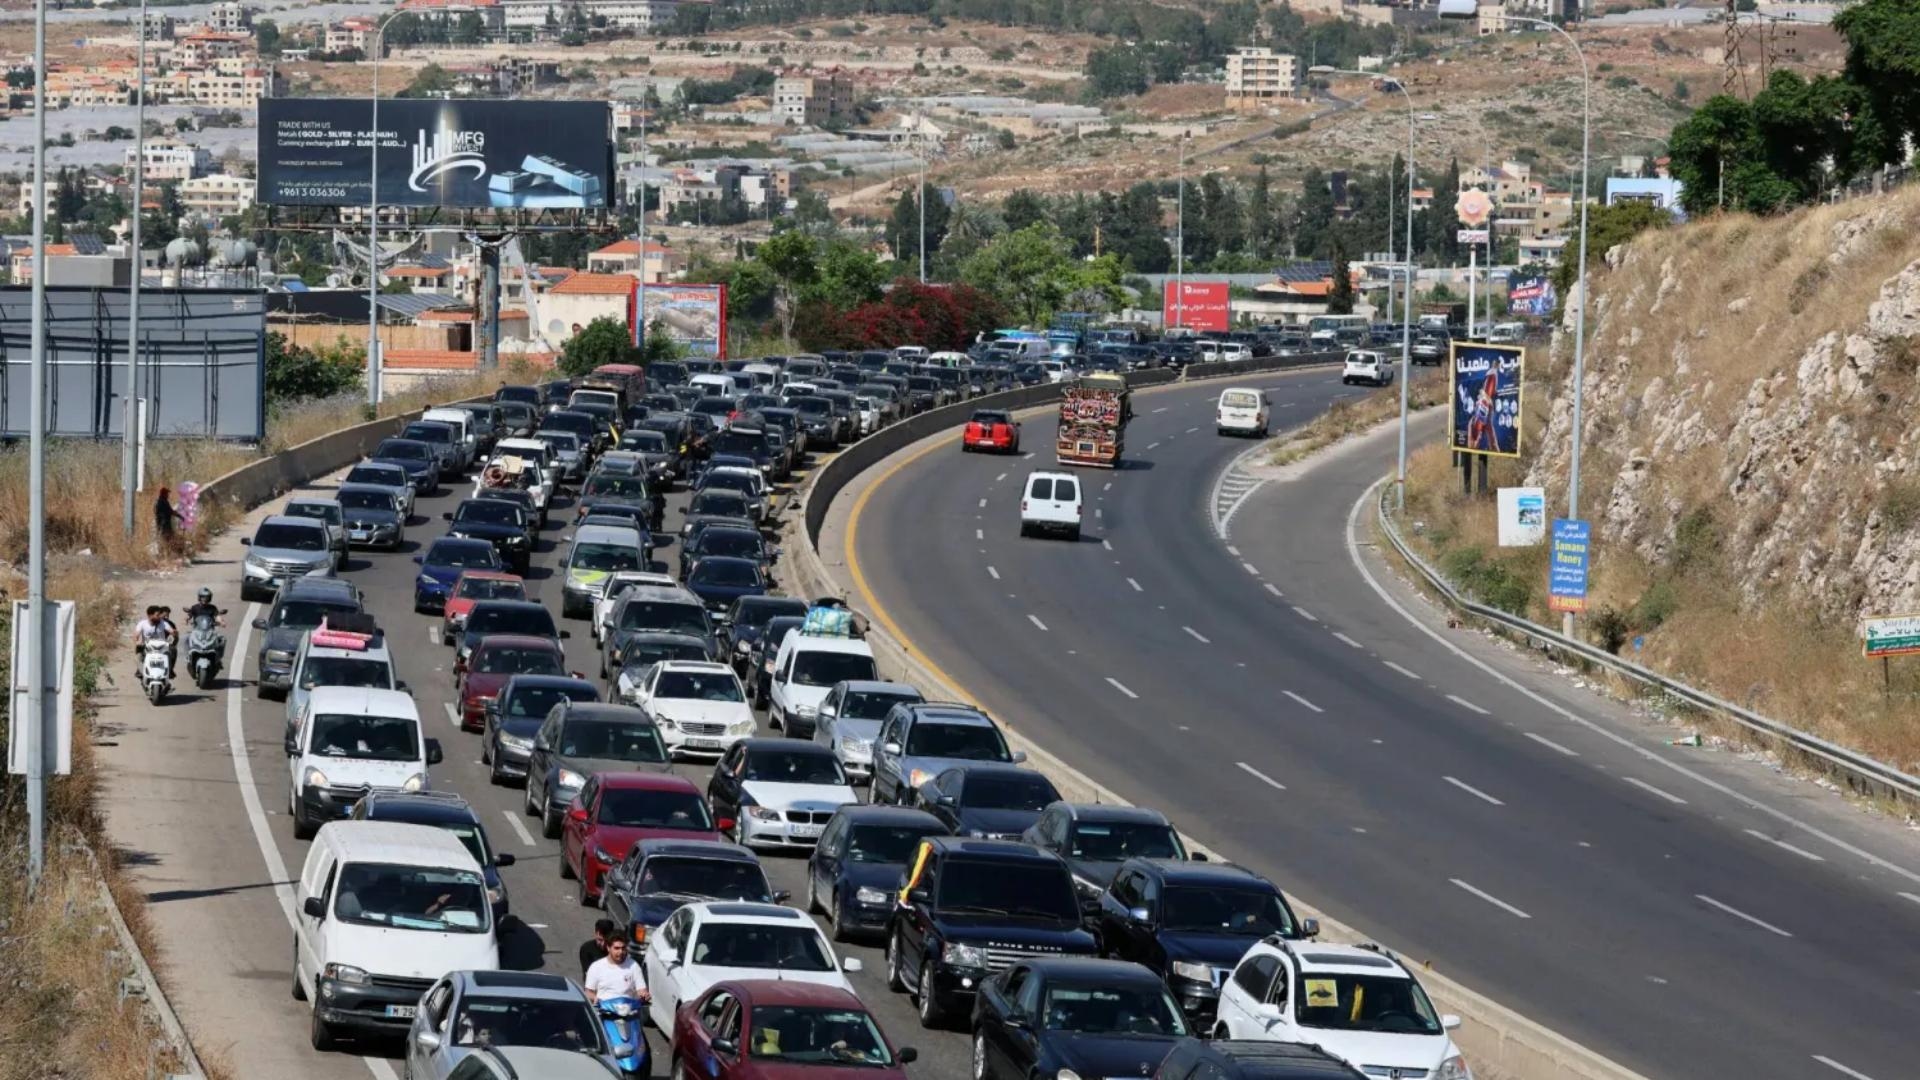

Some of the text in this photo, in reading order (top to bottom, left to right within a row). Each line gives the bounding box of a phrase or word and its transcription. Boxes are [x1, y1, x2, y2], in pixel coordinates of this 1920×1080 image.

[277, 121, 331, 129] TRADE WITH US
[328, 130, 352, 138] SILVER
[357, 130, 398, 138] PLATNUM)
[452, 132, 485, 145] MFG
[453, 144, 483, 152] INVEST
[279, 187, 346, 197] +961 3 036306
